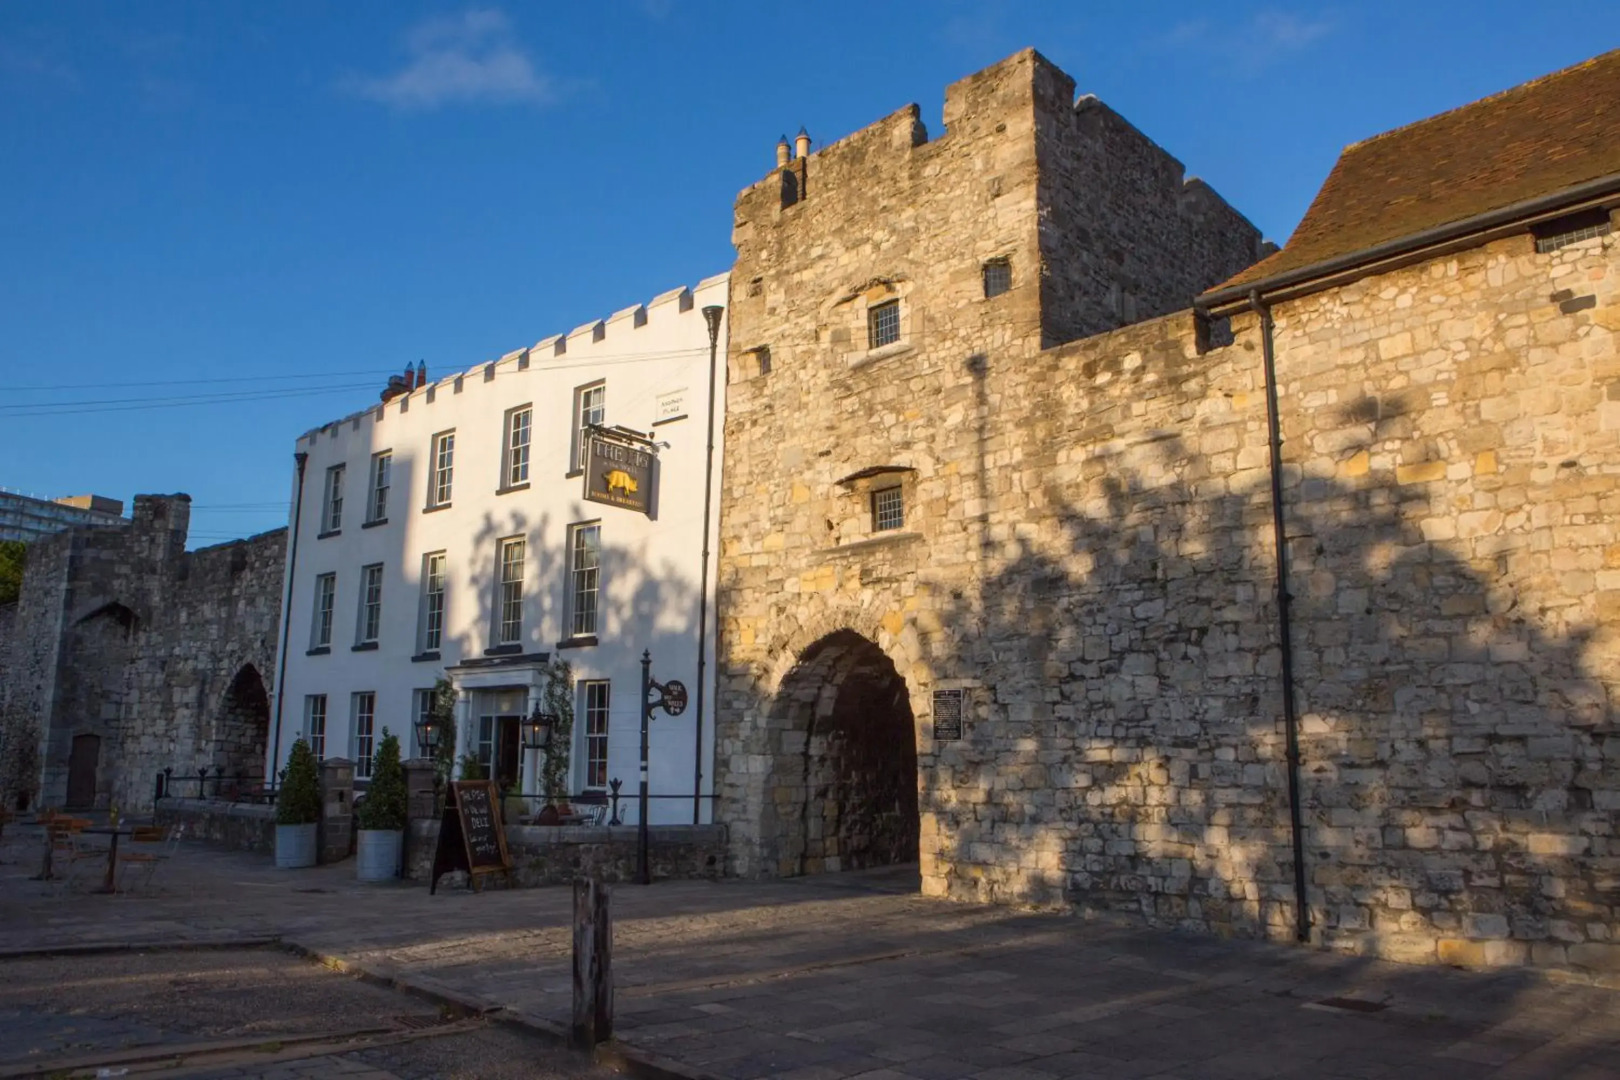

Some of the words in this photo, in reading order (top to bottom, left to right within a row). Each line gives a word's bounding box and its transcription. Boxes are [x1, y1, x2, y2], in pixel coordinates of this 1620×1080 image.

[593, 440, 623, 462] THE
[626, 447, 650, 468] PIG
[471, 816, 490, 829] DELI
